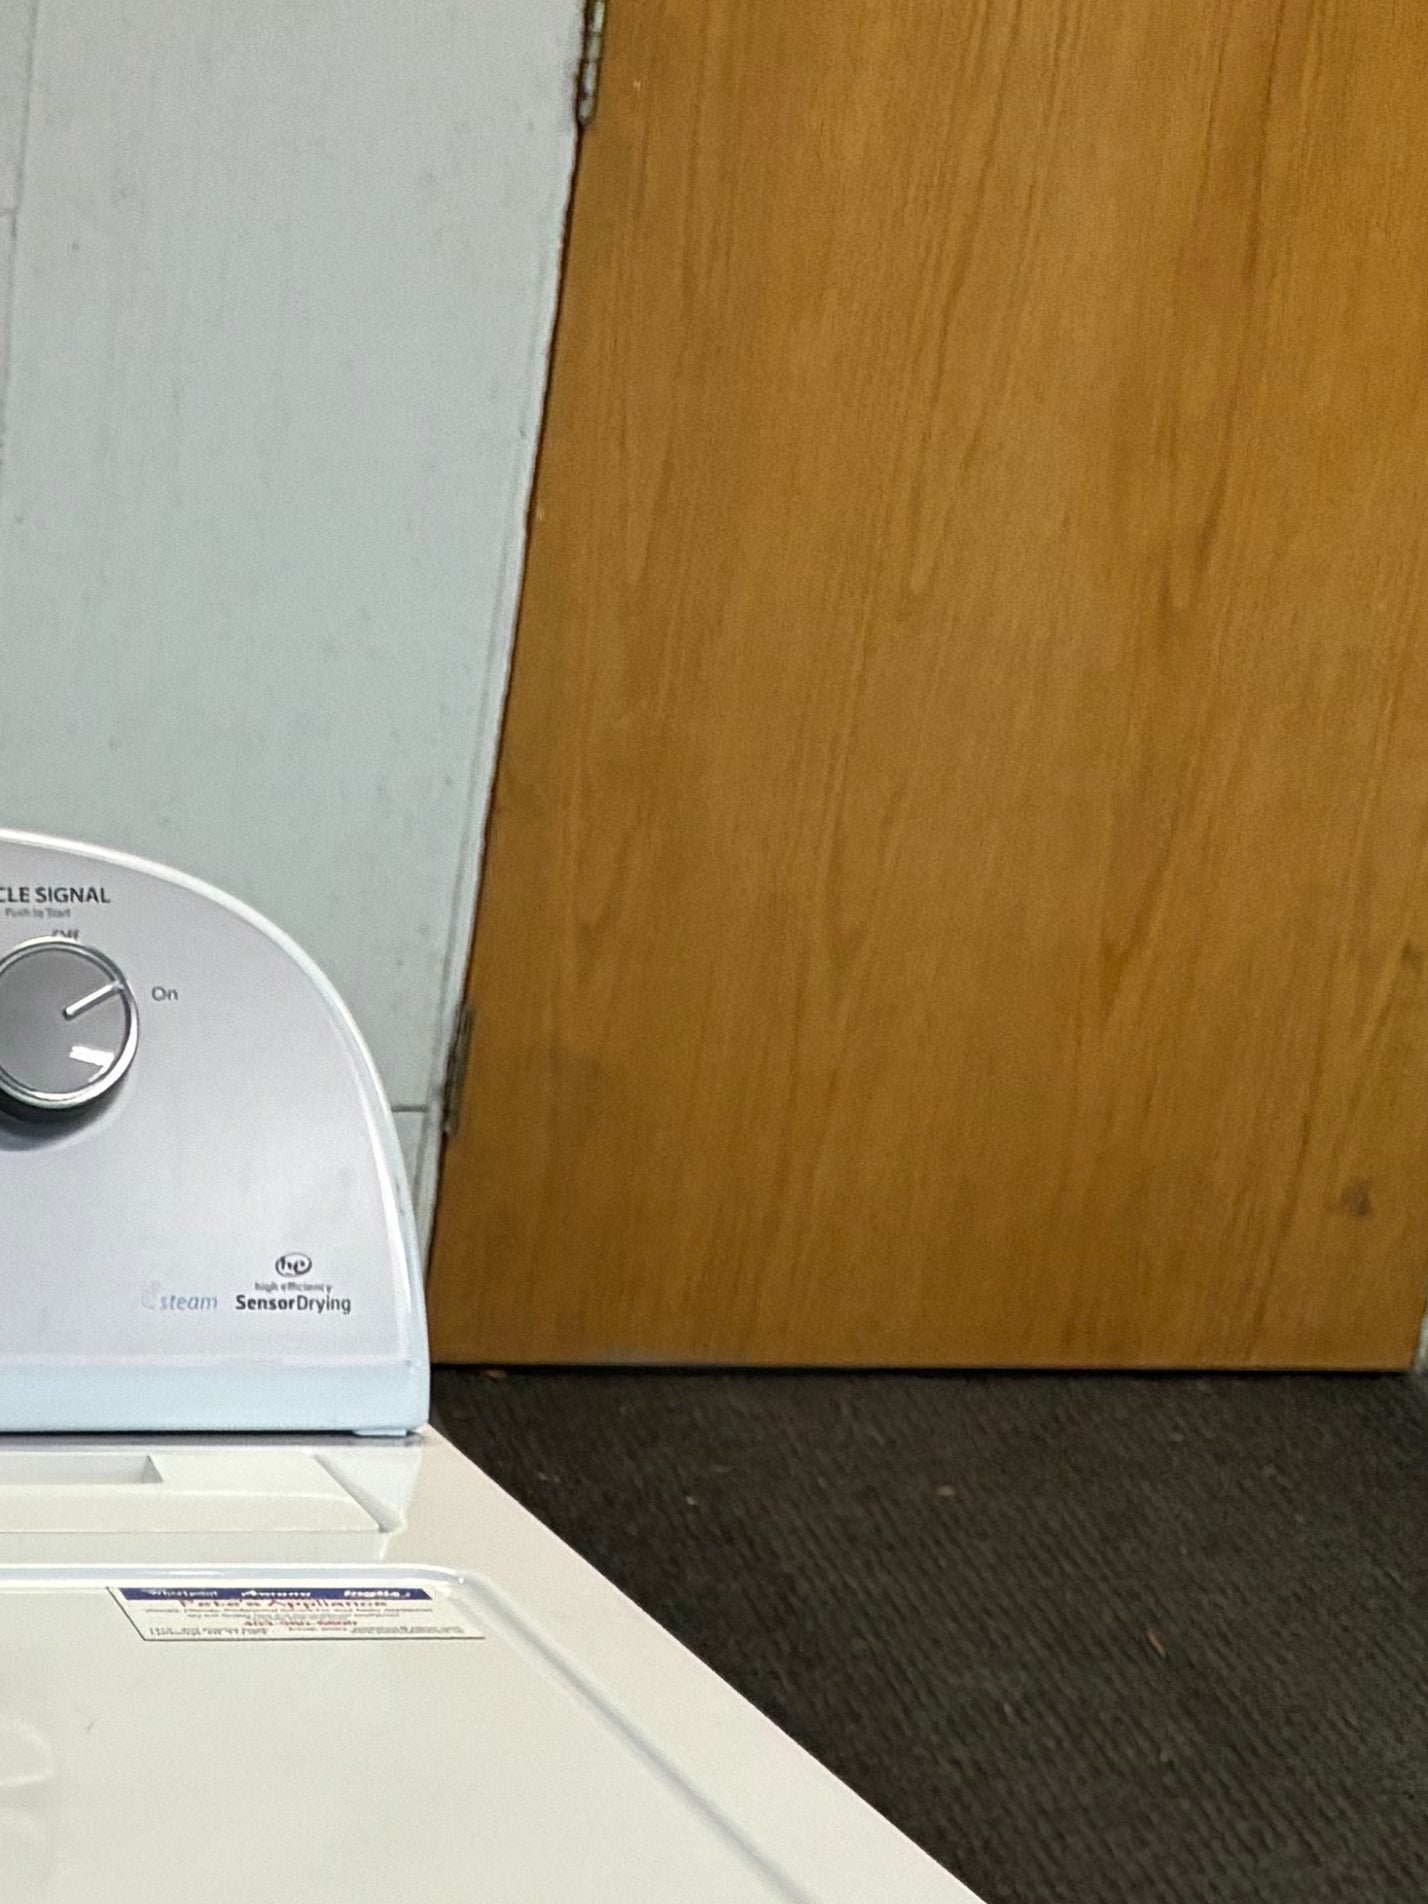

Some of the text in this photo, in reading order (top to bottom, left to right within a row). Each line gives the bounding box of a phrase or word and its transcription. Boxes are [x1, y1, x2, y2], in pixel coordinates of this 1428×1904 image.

[36, 887, 111, 904] SIGNAL
[151, 985, 179, 1002] On
[160, 1295, 218, 1310] steam
[235, 1294, 352, 1315] SensorDrying
